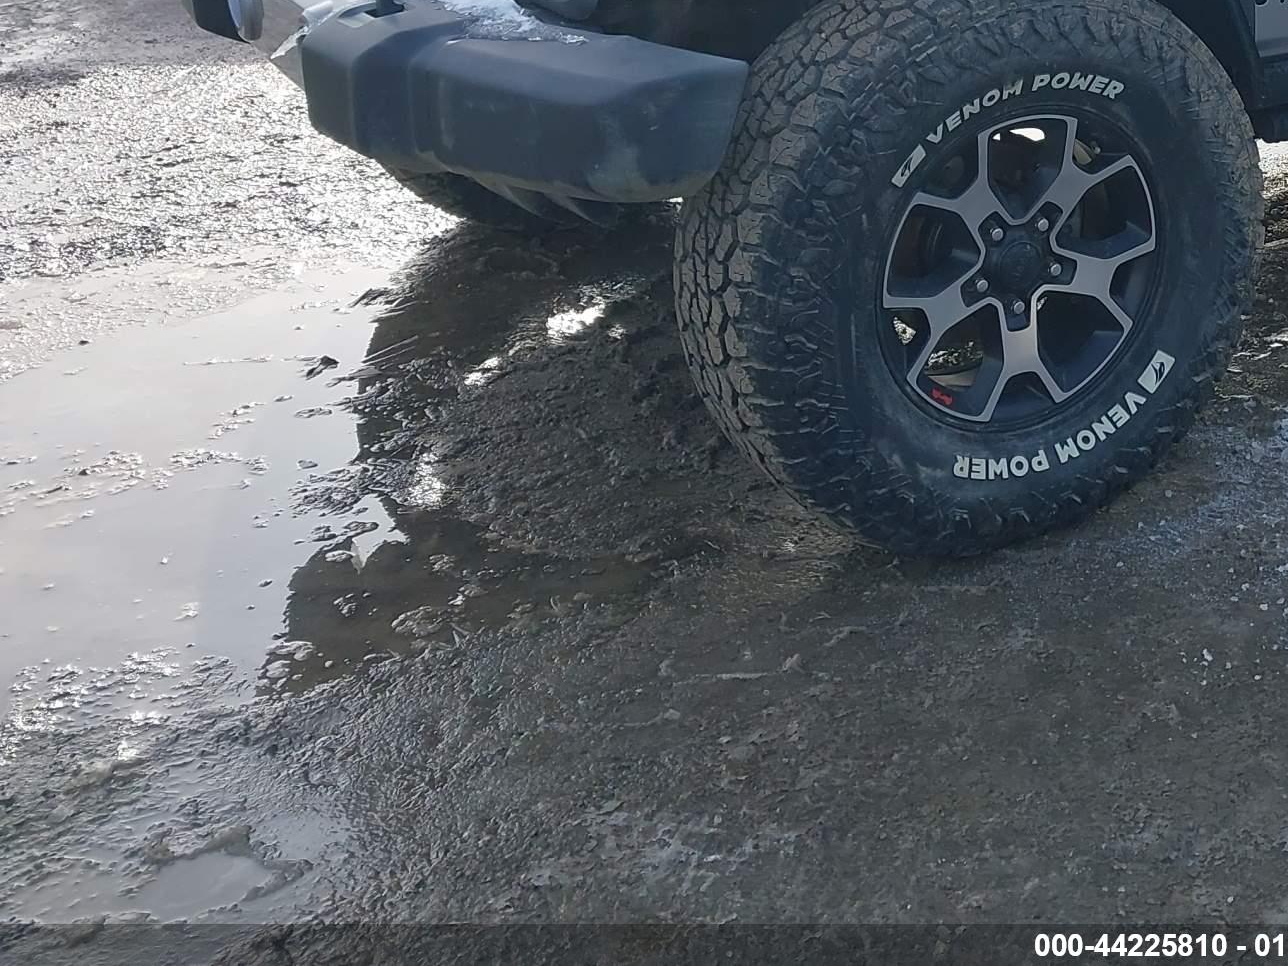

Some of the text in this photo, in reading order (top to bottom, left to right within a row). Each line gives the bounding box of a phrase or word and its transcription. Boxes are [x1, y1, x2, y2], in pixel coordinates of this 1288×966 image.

[926, 71, 1126, 144] VENOM POWER
[953, 391, 1148, 481] VENOM POWER
